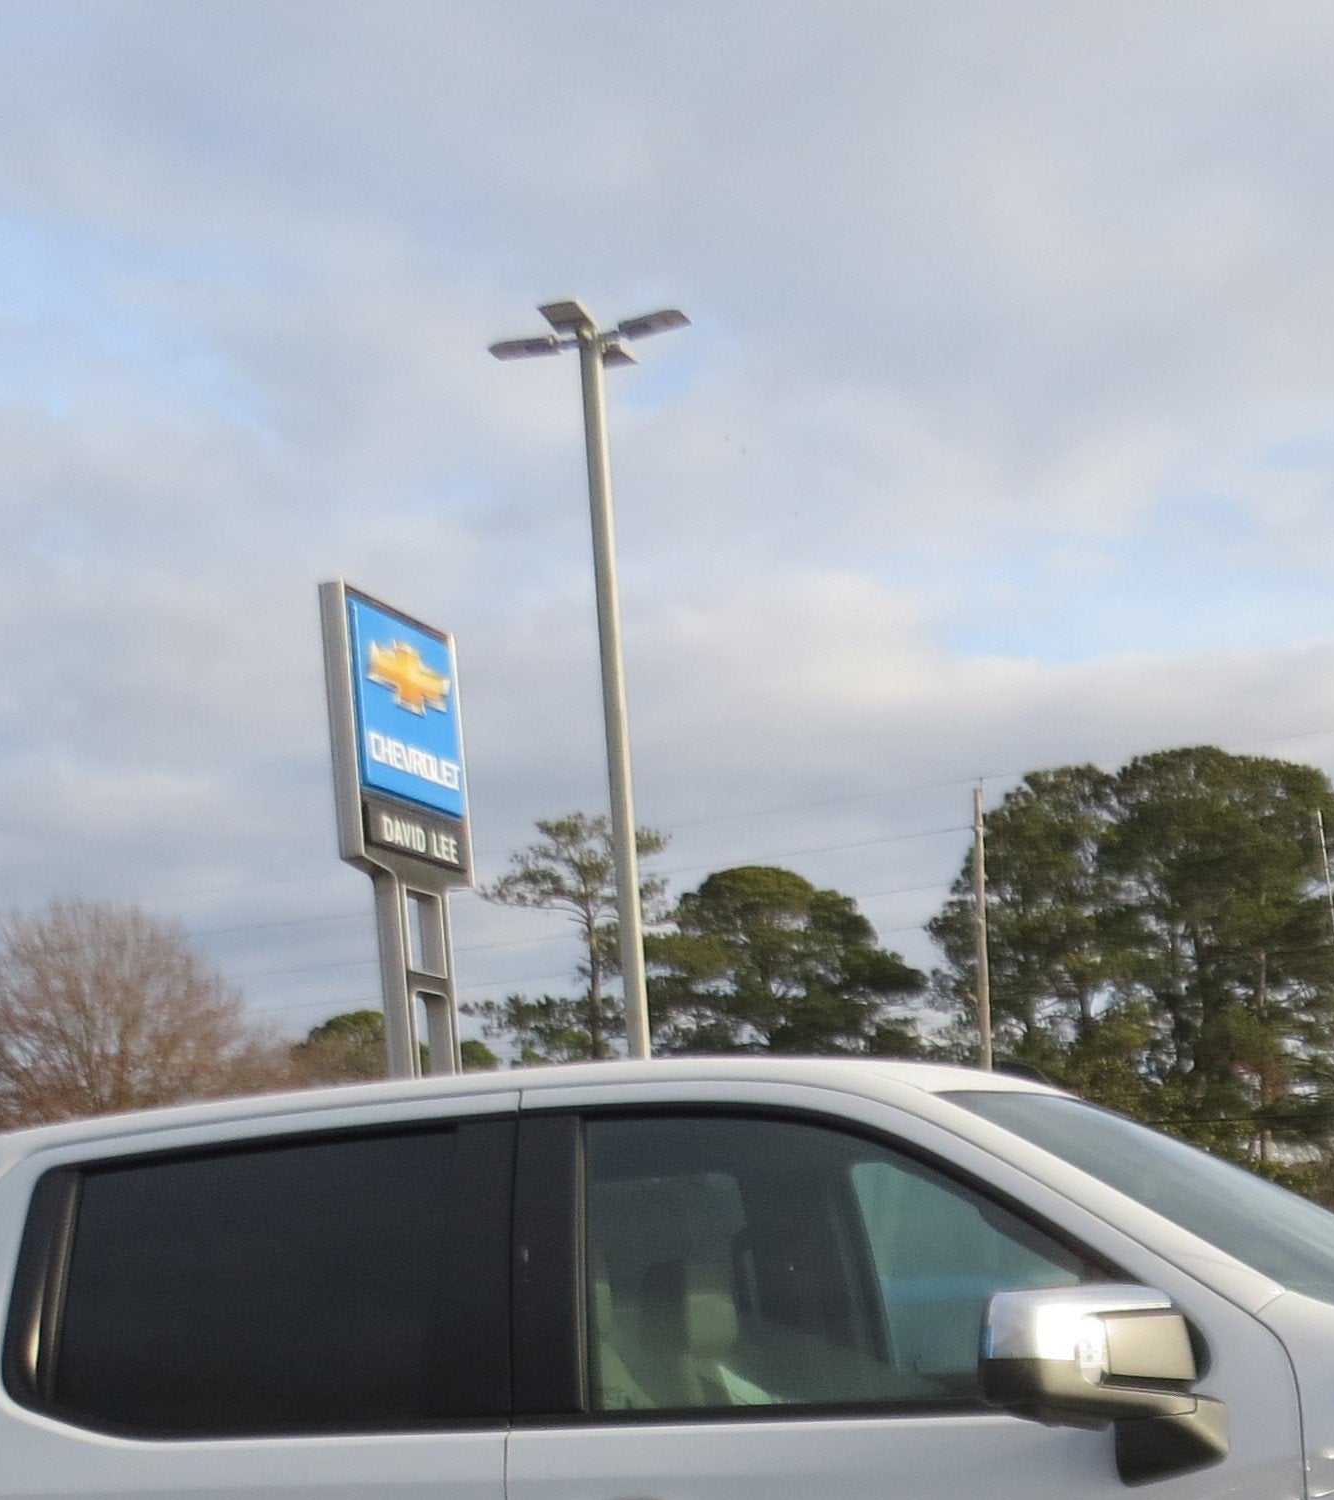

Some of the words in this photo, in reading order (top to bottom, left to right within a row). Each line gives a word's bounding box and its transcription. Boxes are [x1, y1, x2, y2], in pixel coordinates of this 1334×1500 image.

[369, 731, 461, 791] CHEVROLET
[381, 816, 427, 854] DAVID
[432, 831, 460, 865] LEE
